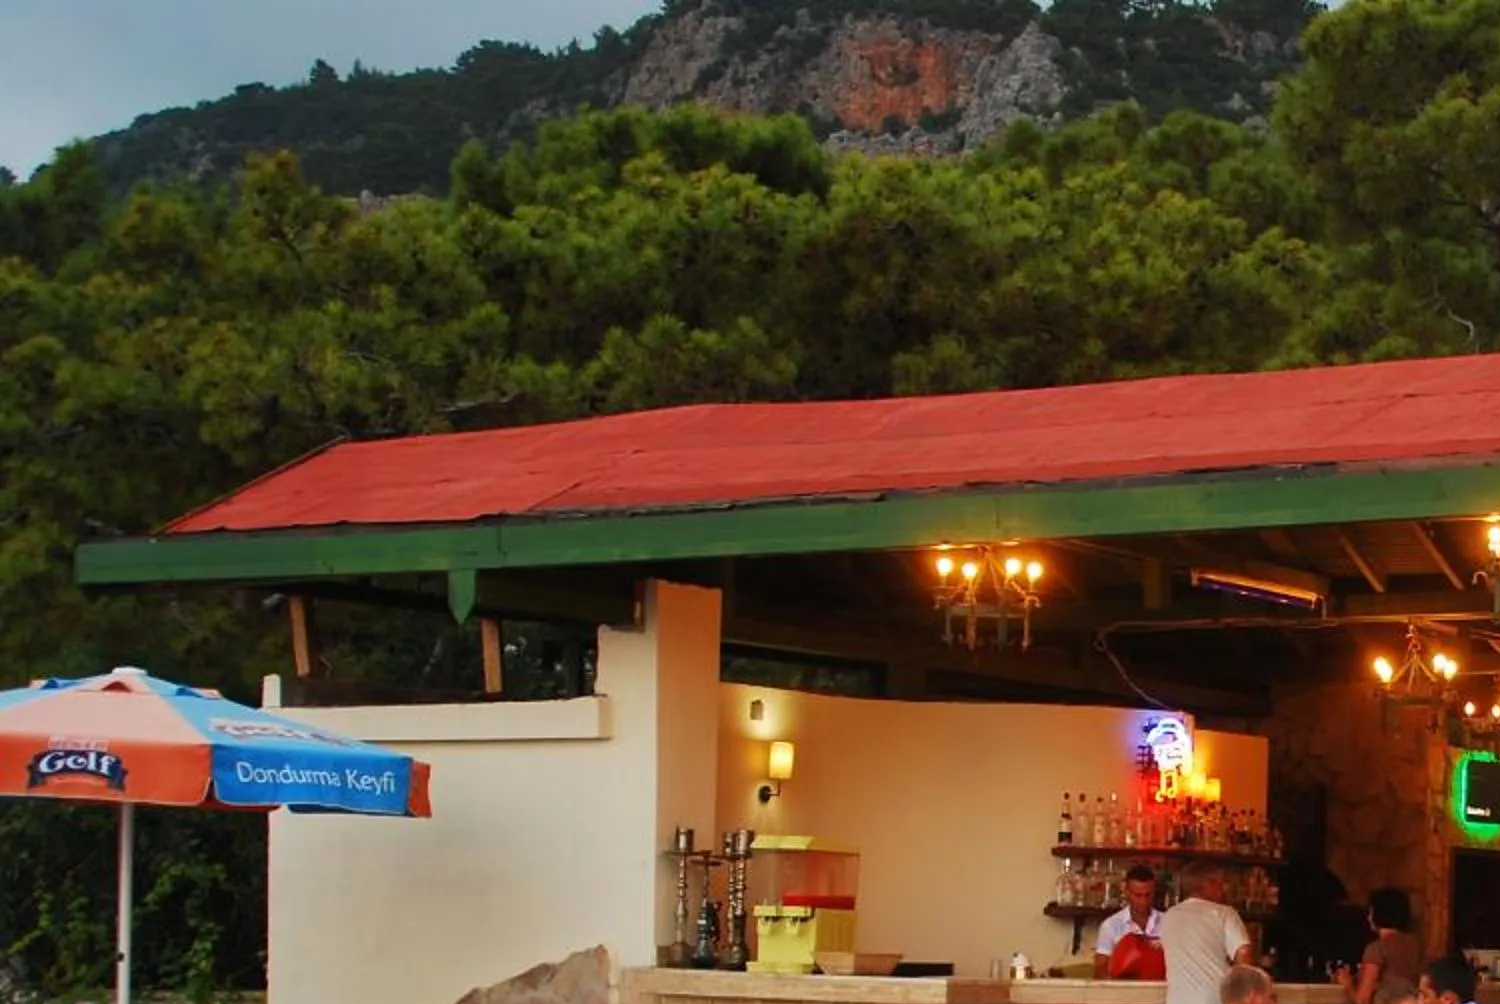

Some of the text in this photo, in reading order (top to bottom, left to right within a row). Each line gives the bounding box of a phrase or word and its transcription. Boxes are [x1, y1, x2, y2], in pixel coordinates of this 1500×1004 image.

[39, 751, 116, 777] Golf
[236, 761, 396, 796] Dondurma Keyfi
